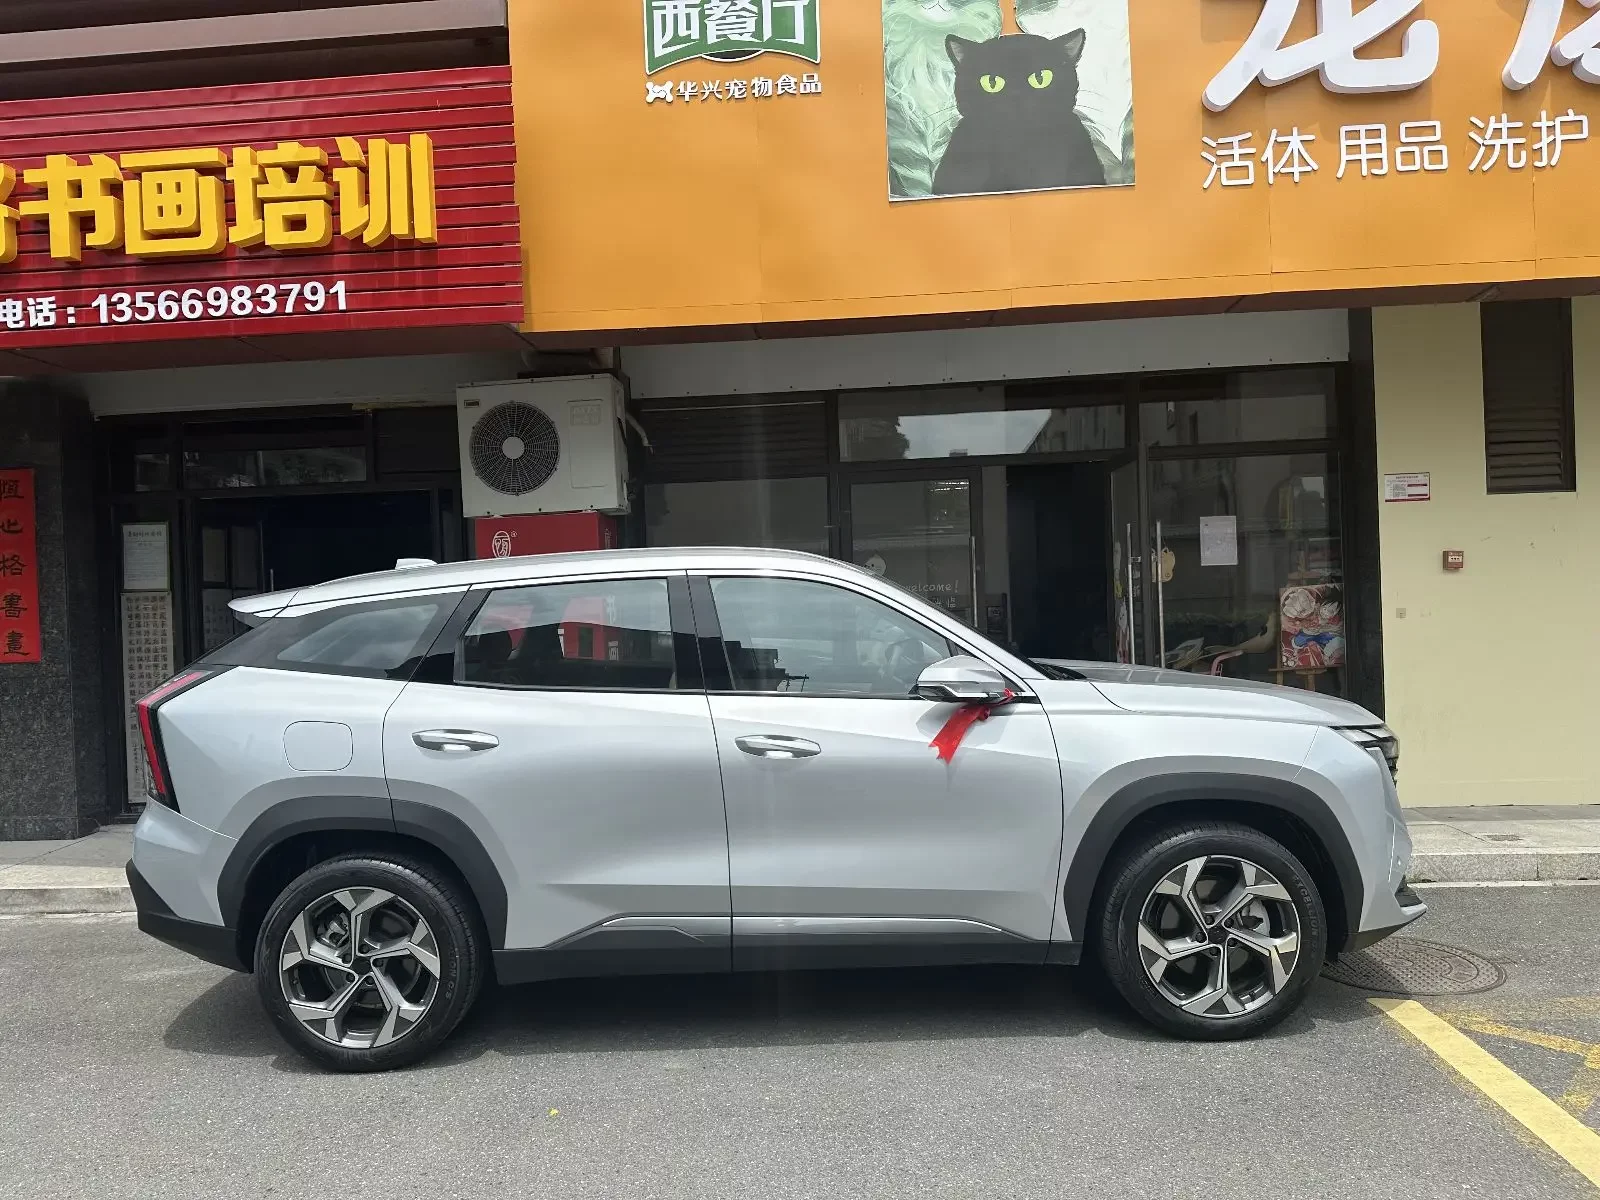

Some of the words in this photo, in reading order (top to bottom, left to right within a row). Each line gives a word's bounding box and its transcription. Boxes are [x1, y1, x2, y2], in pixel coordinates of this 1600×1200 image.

[651, 0, 809, 58] 西餐厅
[676, 72, 822, 101] 华兴宠物食品
[1200, 127, 1319, 189] 活体
[1335, 120, 1449, 179] 用品
[1467, 109, 1590, 172] 洗护
[0, 132, 438, 263] 书画培训
[91, 281, 349, 324] 13566983791
